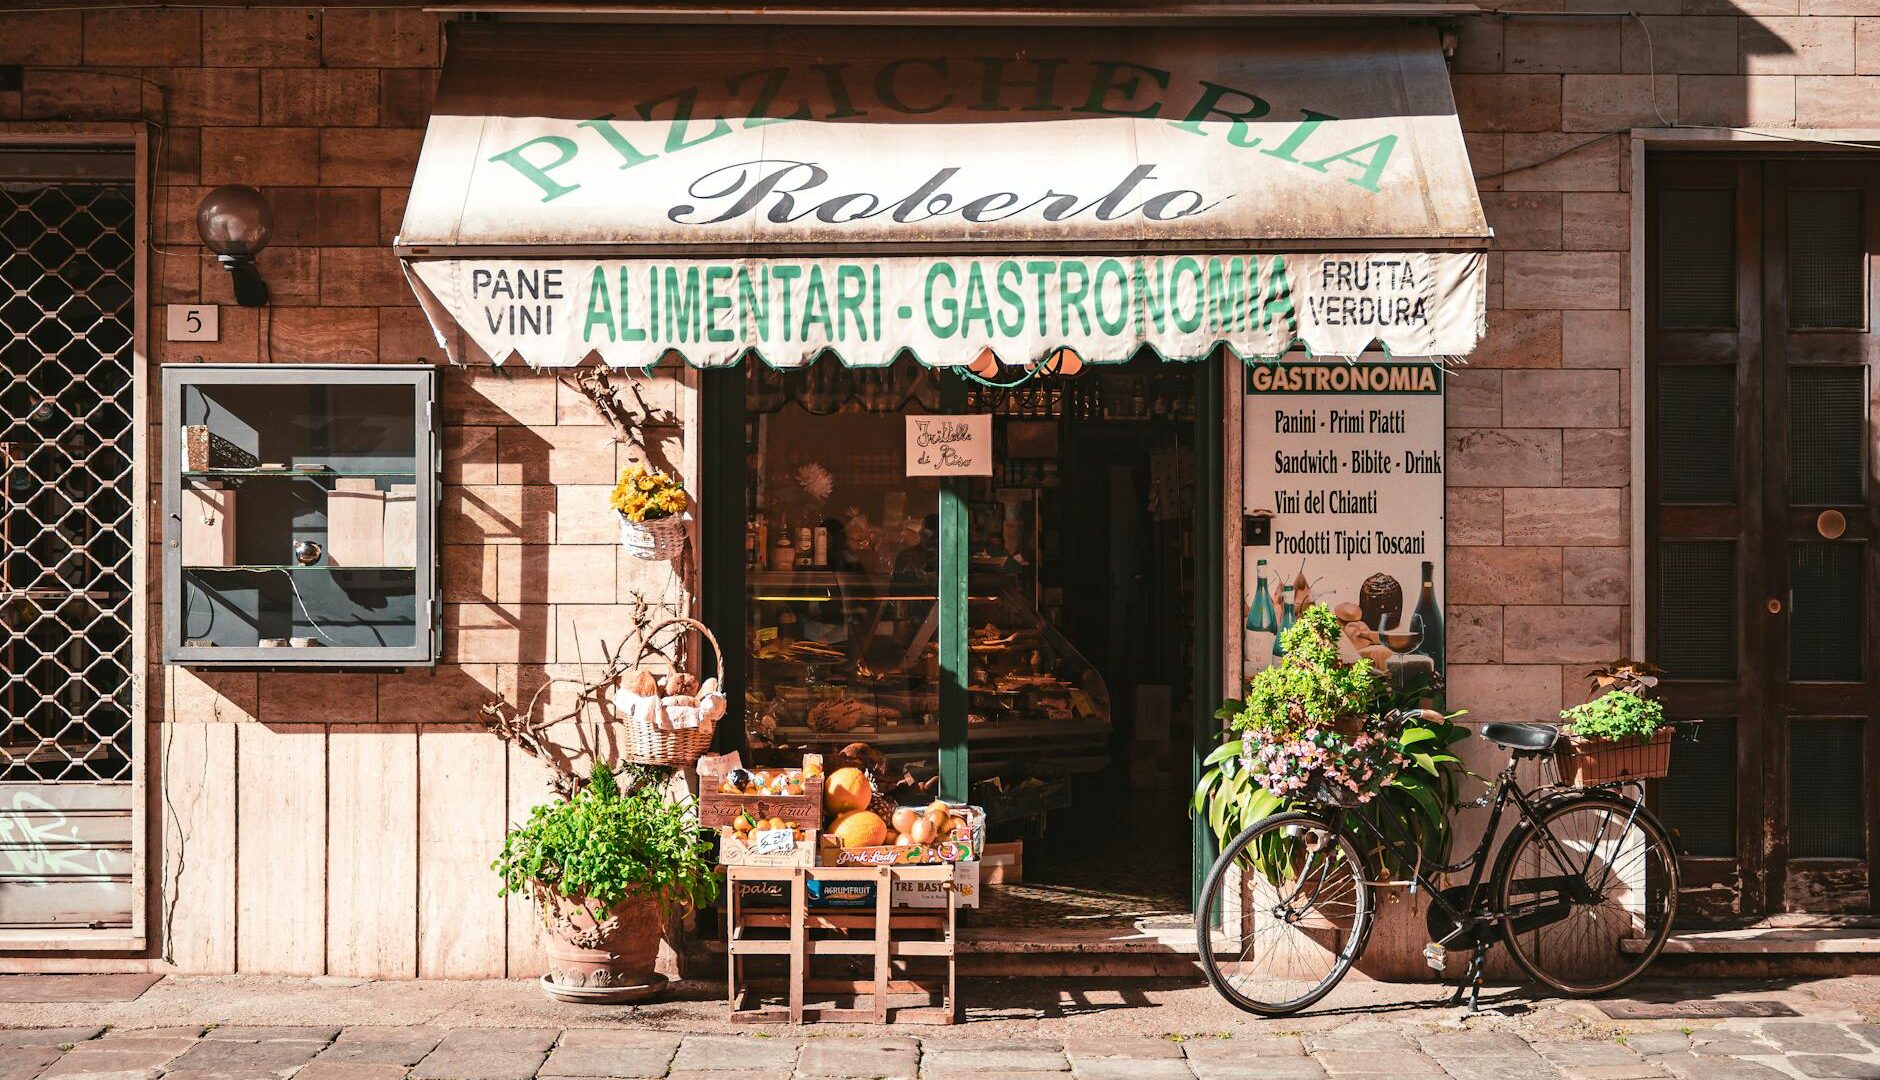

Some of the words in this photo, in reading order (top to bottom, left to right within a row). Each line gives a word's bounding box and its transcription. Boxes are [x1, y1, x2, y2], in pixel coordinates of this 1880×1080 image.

[488, 56, 1400, 203] PIZZICHERIA
[667, 159, 1236, 225] Roberto
[472, 269, 564, 300] PANE
[1322, 261, 1415, 291] FRUTTA
[583, 264, 881, 344] ALIMENTARI
[924, 256, 1297, 339] GASTRONOMIA
[1309, 296, 1429, 327] VERDURA
[186, 310, 202, 333] 5
[485, 305, 553, 336] VINI
[1252, 366, 1437, 391] GASTRONOMIA
[1275, 409, 1316, 433] Panini
[1330, 409, 1364, 433] Primi
[1369, 409, 1405, 433] Piatti
[918, 451, 931, 464] di
[934, 444, 972, 469] Riso
[1275, 450, 1338, 474] Sandwich
[1352, 450, 1391, 474] Bibite
[1405, 450, 1442, 474] Drink
[1275, 490, 1300, 514] Vini
[1304, 490, 1325, 514] del
[1329, 490, 1377, 514] Chianti
[1275, 530, 1330, 554] Prodotti
[1334, 530, 1371, 560] Tipici
[1375, 530, 1425, 554] Toscani
[837, 851, 868, 865] Pink
[868, 850, 899, 864] Lady
[894, 882, 914, 892] TRE
[917, 882, 963, 893] BASTNI
